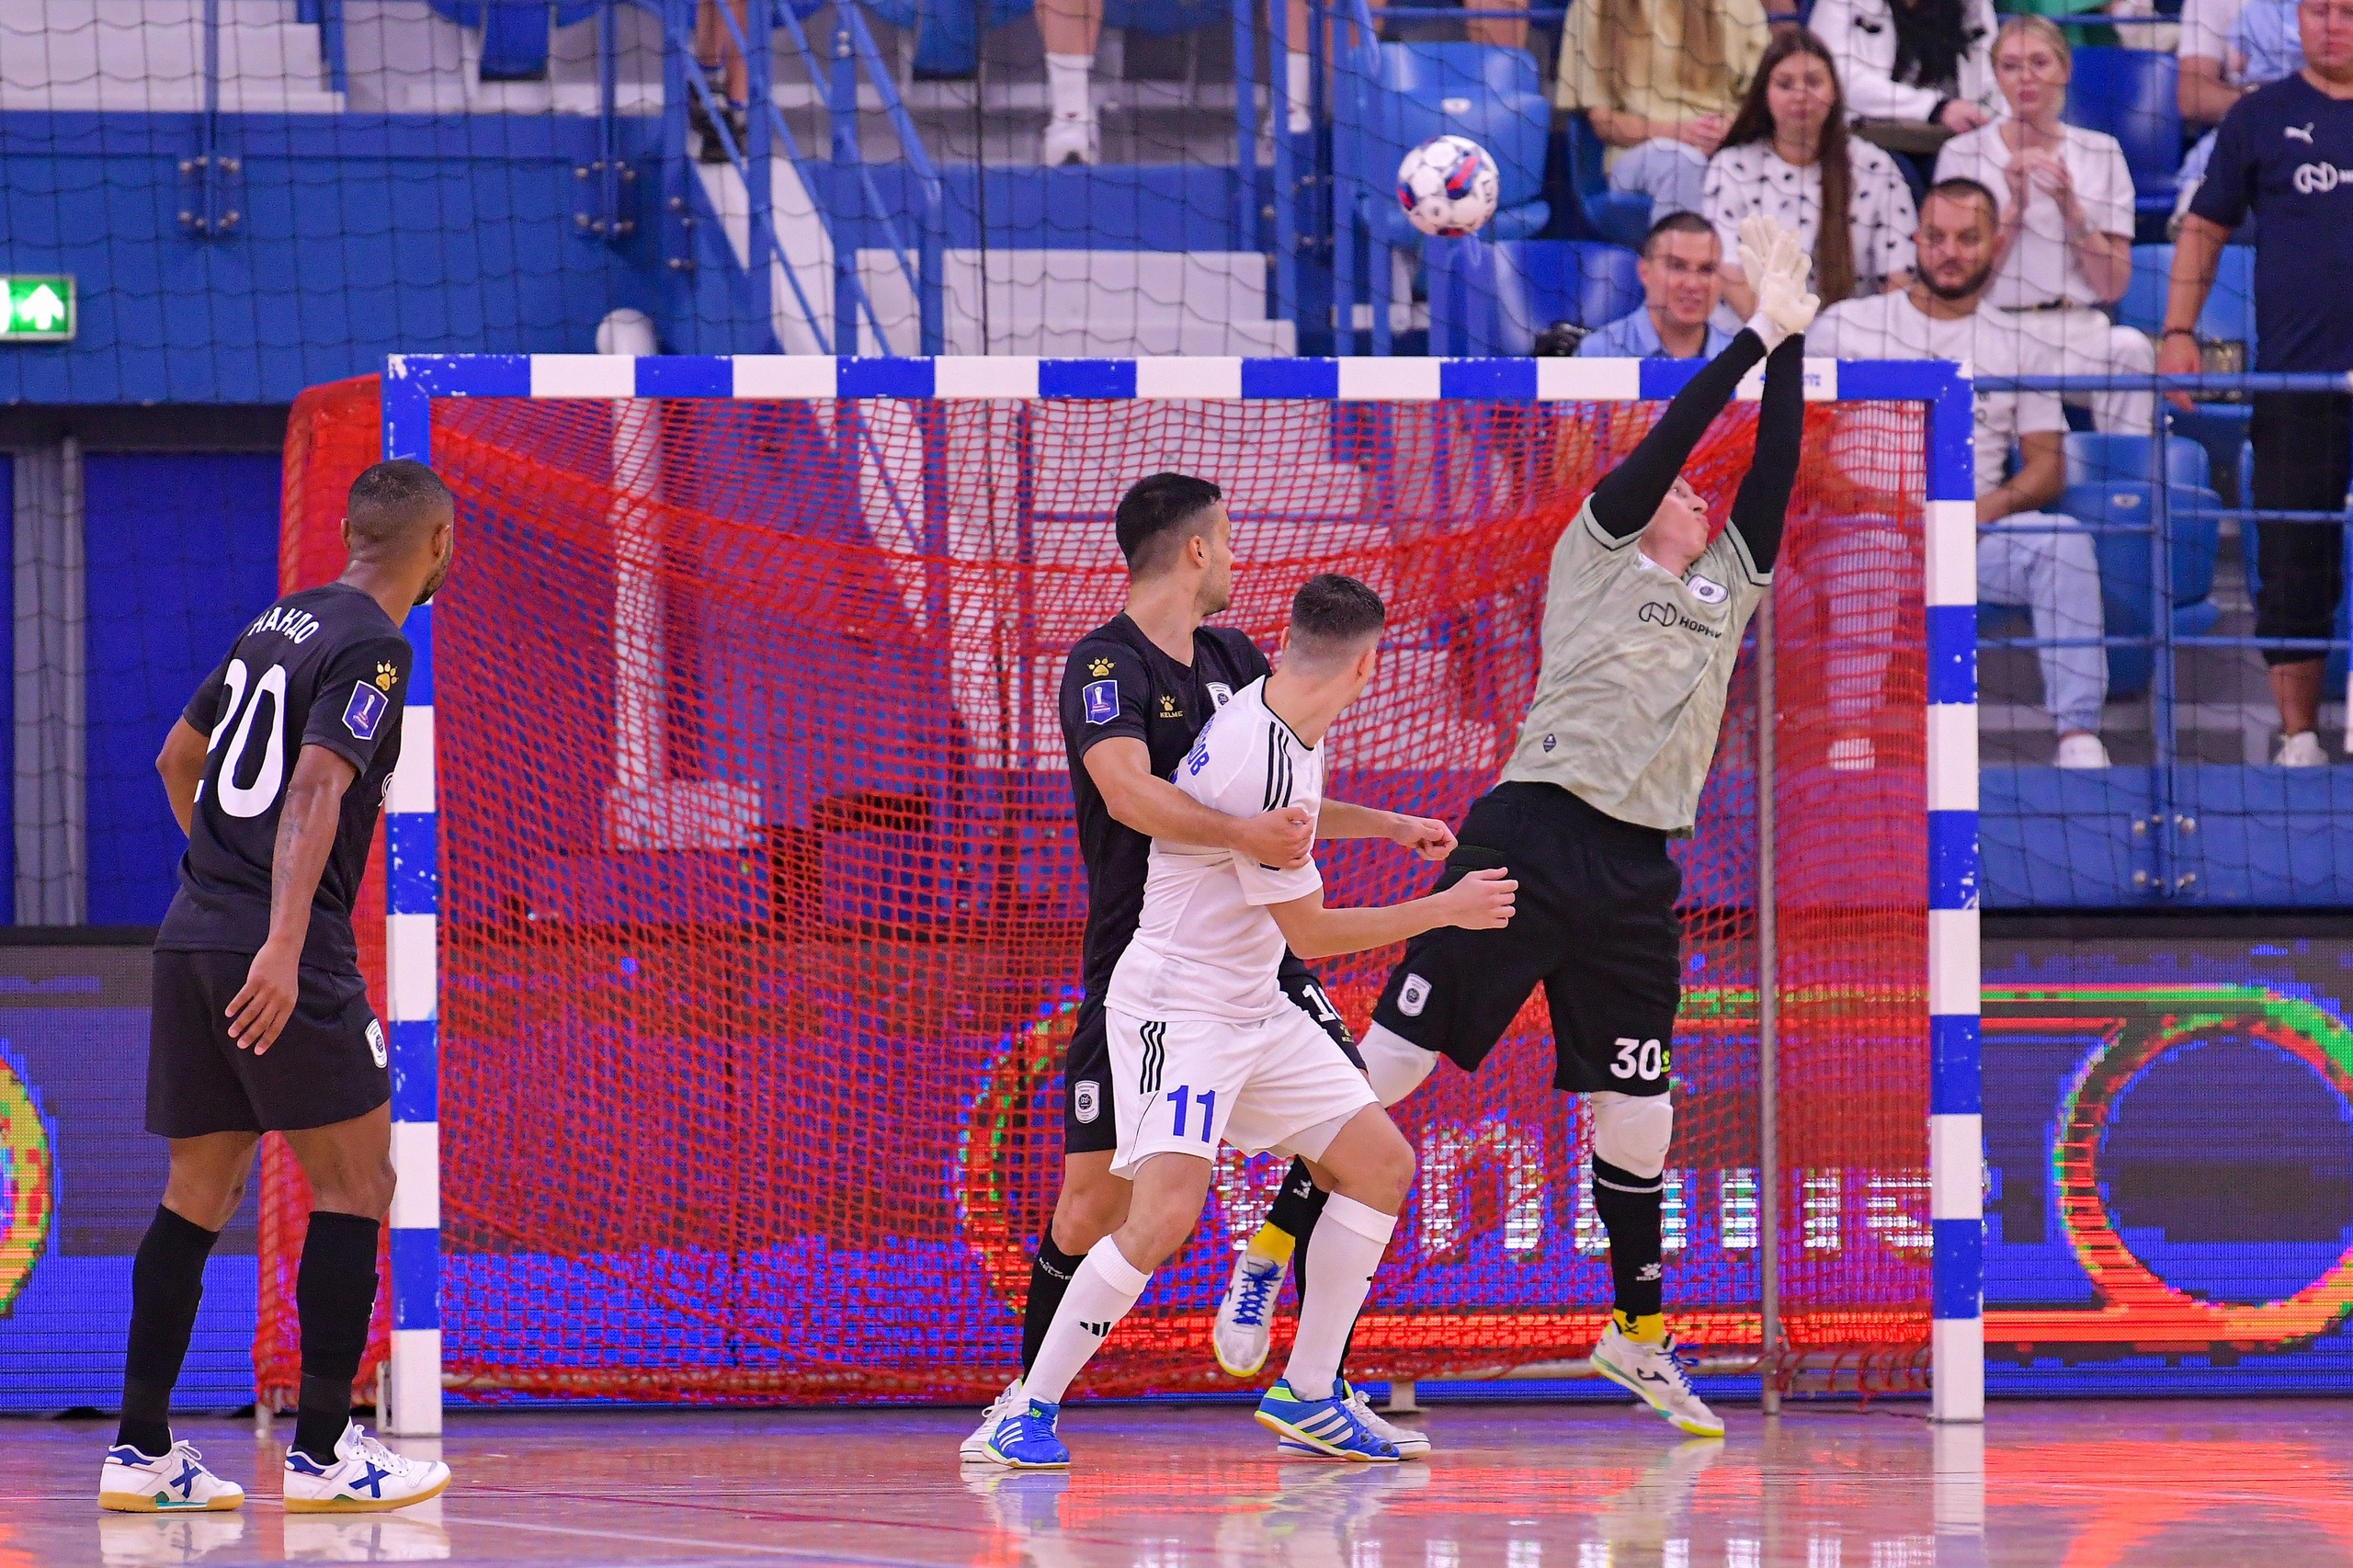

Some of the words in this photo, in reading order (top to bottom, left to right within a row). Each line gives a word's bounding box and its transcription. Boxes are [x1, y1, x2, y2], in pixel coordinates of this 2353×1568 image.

[1159, 710, 1184, 719] KELME
[194, 658, 287, 818] 20
[1302, 984, 1343, 1022] 1
[1610, 1037, 1662, 1081] 30
[1166, 1085, 1216, 1143] 11
